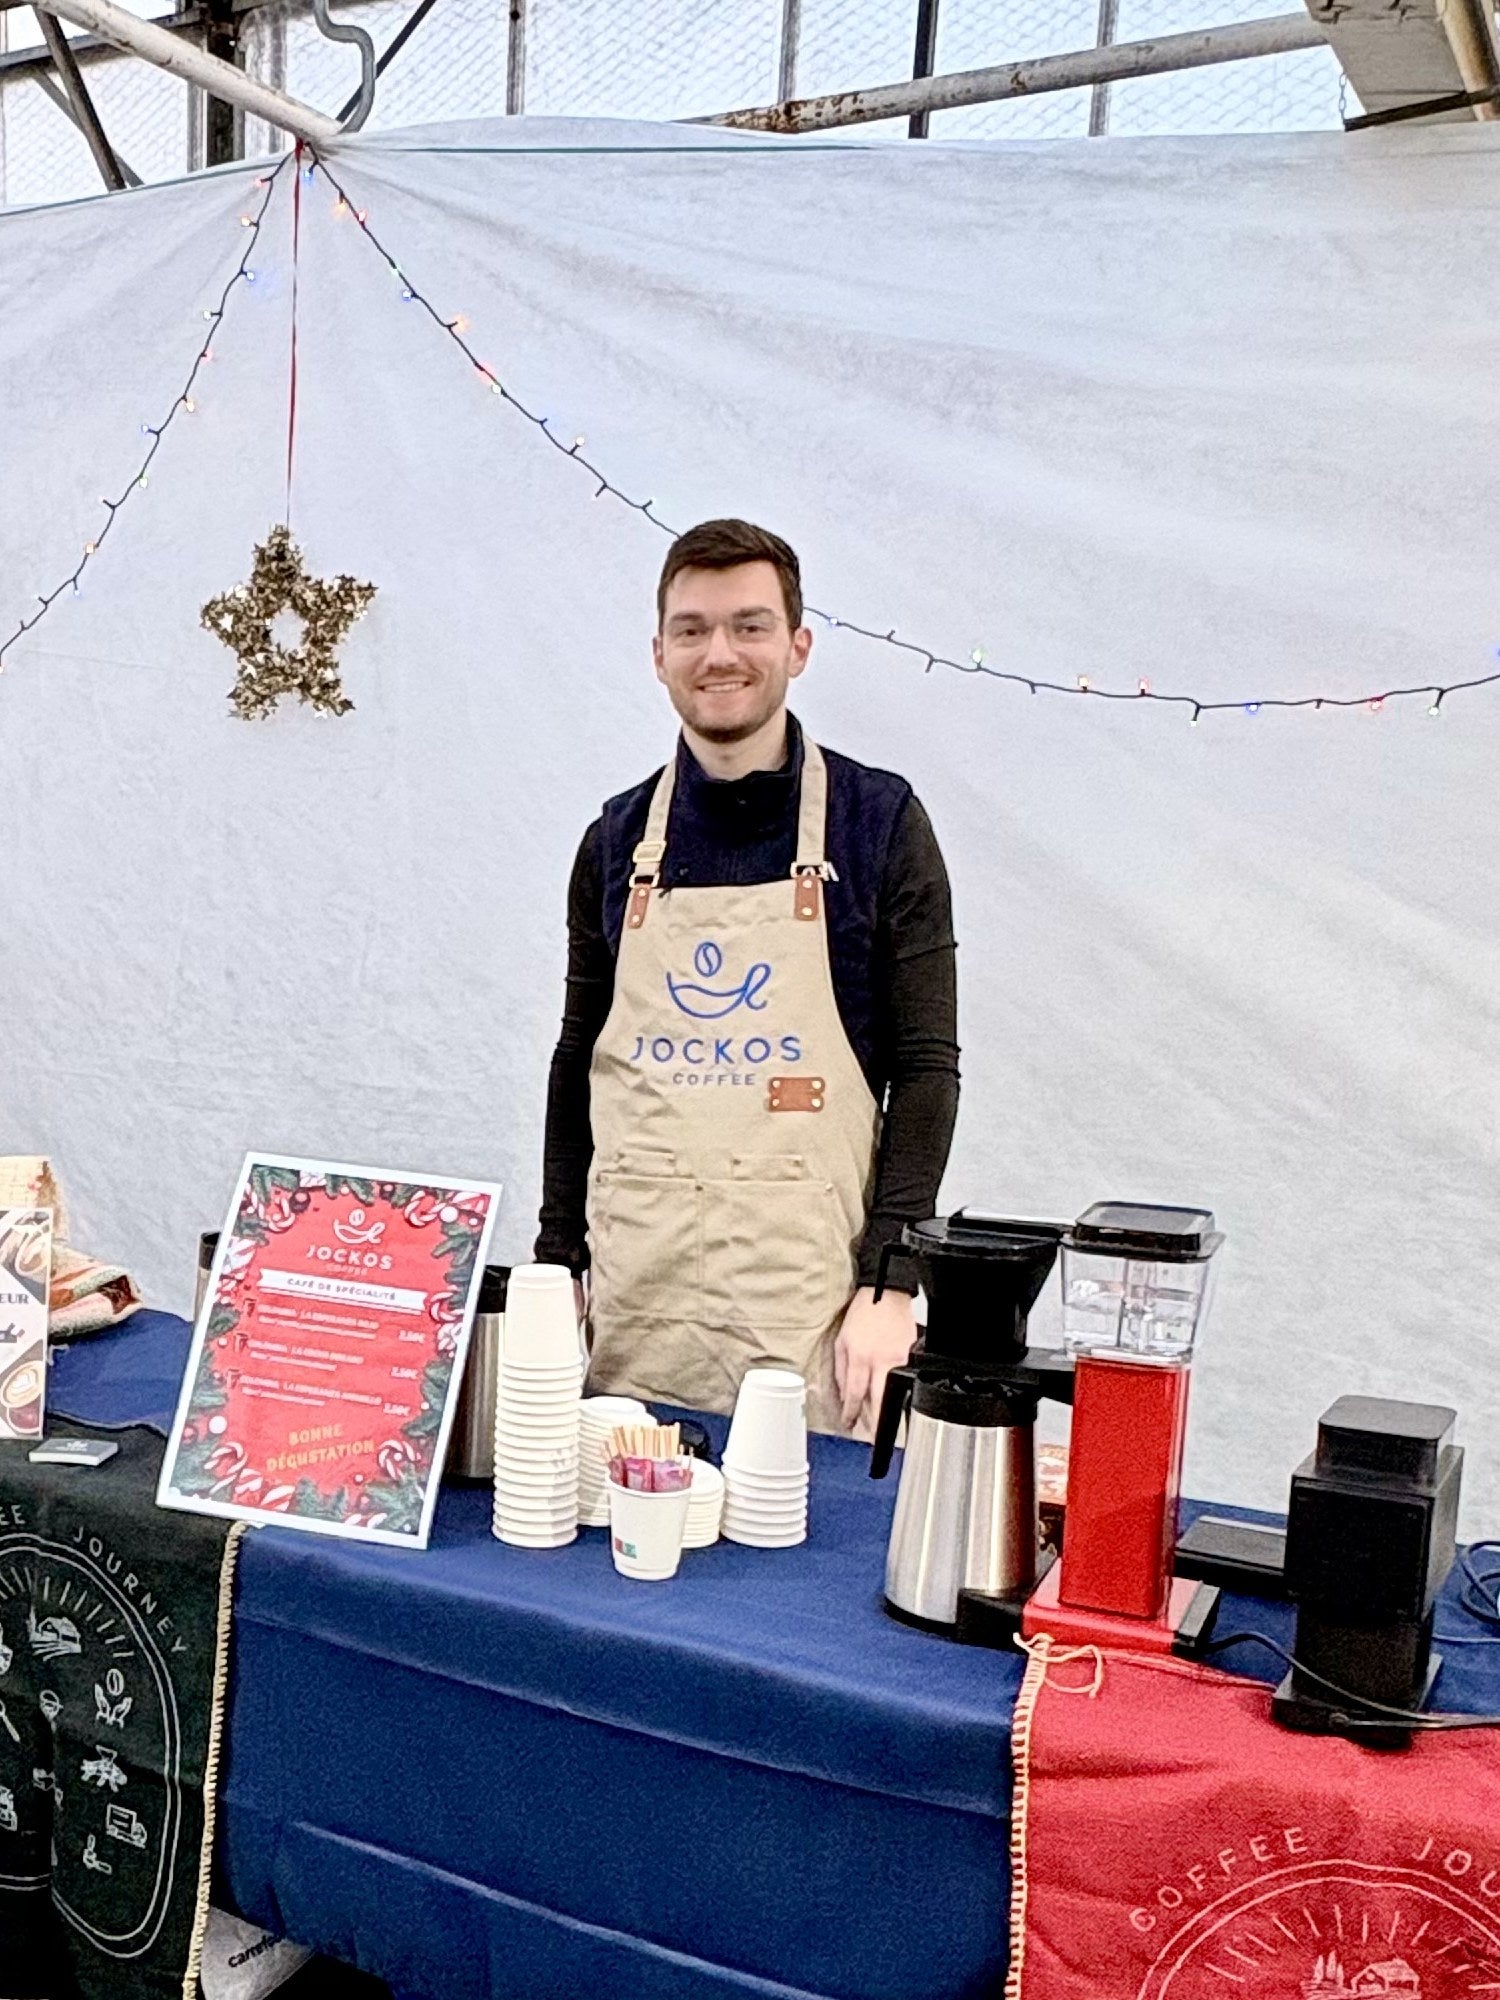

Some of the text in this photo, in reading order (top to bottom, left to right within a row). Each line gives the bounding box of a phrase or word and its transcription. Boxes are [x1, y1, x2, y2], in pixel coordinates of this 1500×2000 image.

[631, 1036, 801, 1064] JOCKOS
[673, 1072, 756, 1086] COFFEE
[306, 1245, 393, 1270] JOCKOS
[287, 1278, 396, 1301] CAFÉ DE SPÉCIALITÉ
[288, 1424, 342, 1446] BONNE
[266, 1440, 374, 1471] DÉGUSTATION
[73, 1526, 187, 1652] JOURNEY
[1129, 1827, 1307, 1932] COFFEE
